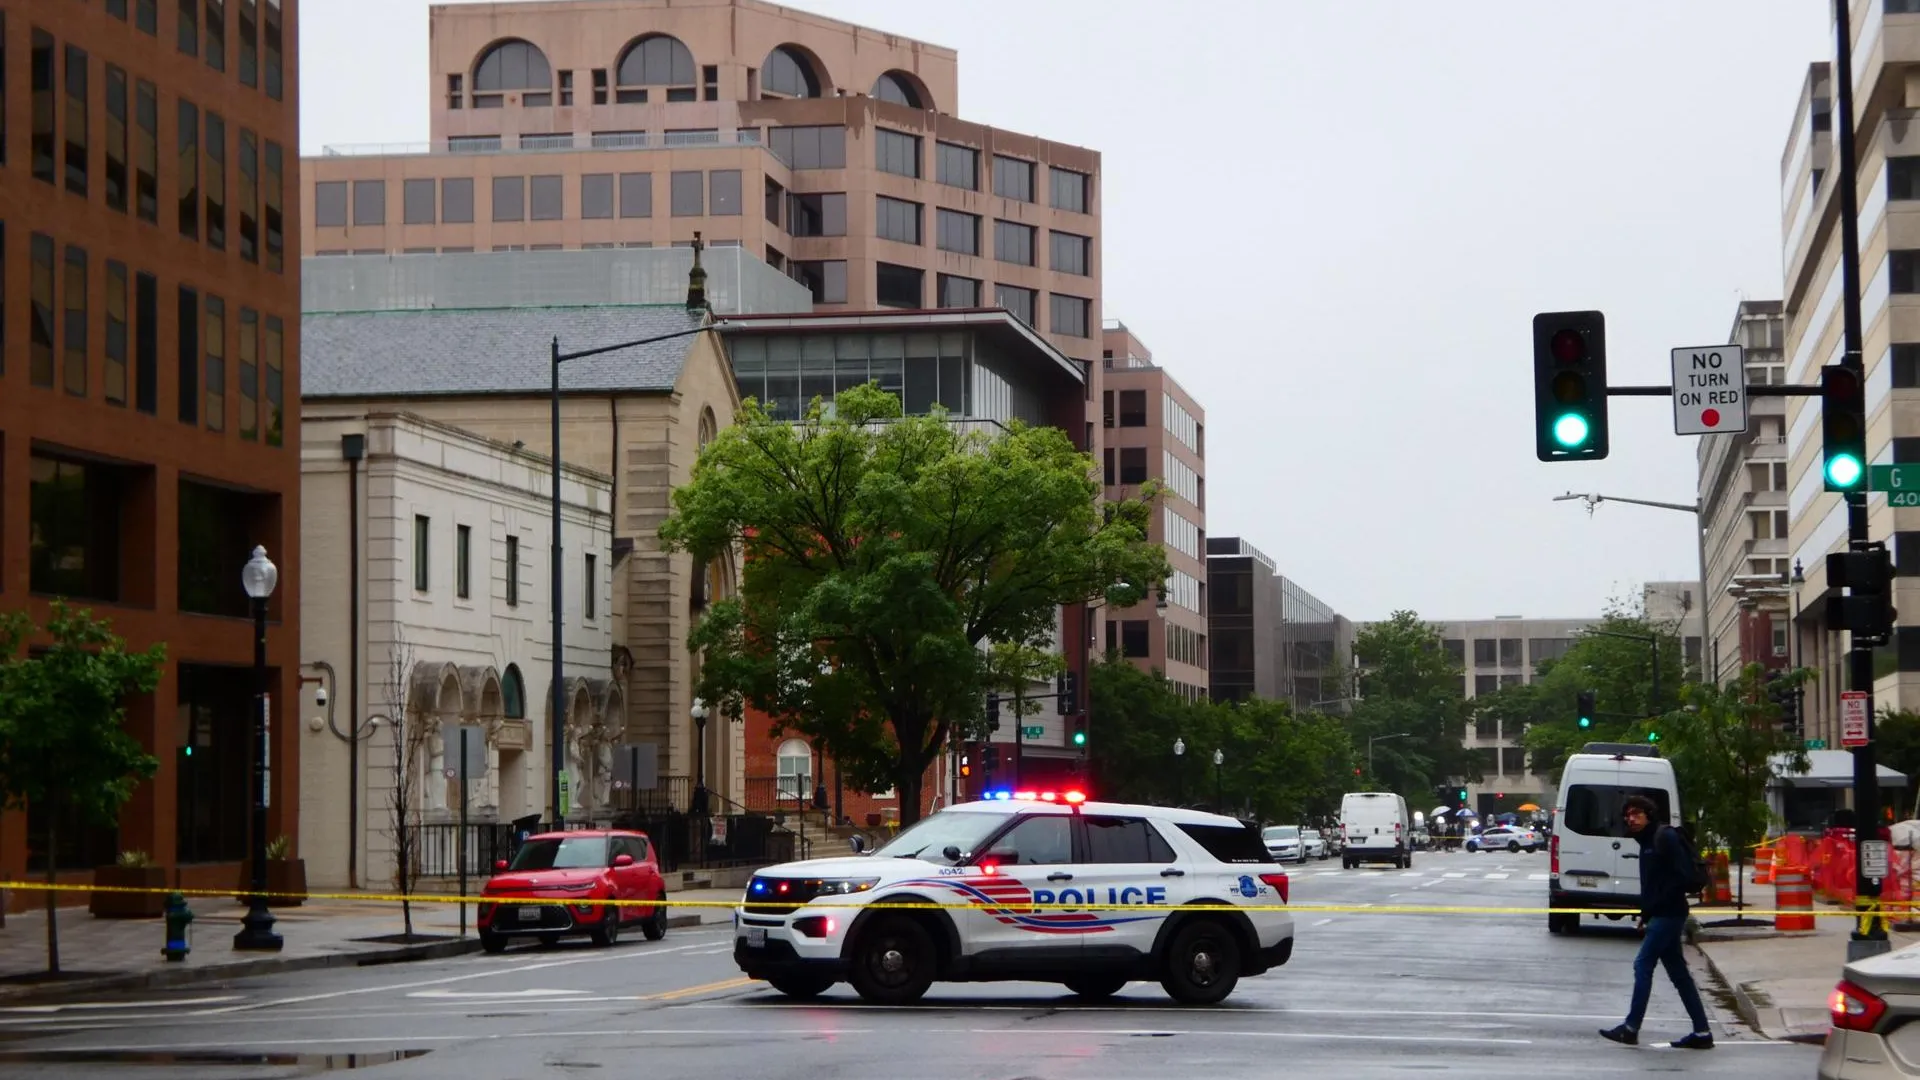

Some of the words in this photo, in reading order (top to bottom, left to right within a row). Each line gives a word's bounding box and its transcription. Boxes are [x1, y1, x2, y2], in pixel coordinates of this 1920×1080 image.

[1692, 352, 1722, 369] NO
[1688, 373, 1729, 387] TURN
[1680, 393, 1701, 406] ON
[1709, 390, 1738, 405] RED
[1890, 467, 1902, 488] G
[1893, 492, 1920, 506] 40
[938, 867, 966, 876] 4042
[1033, 886, 1169, 913] POLICE
